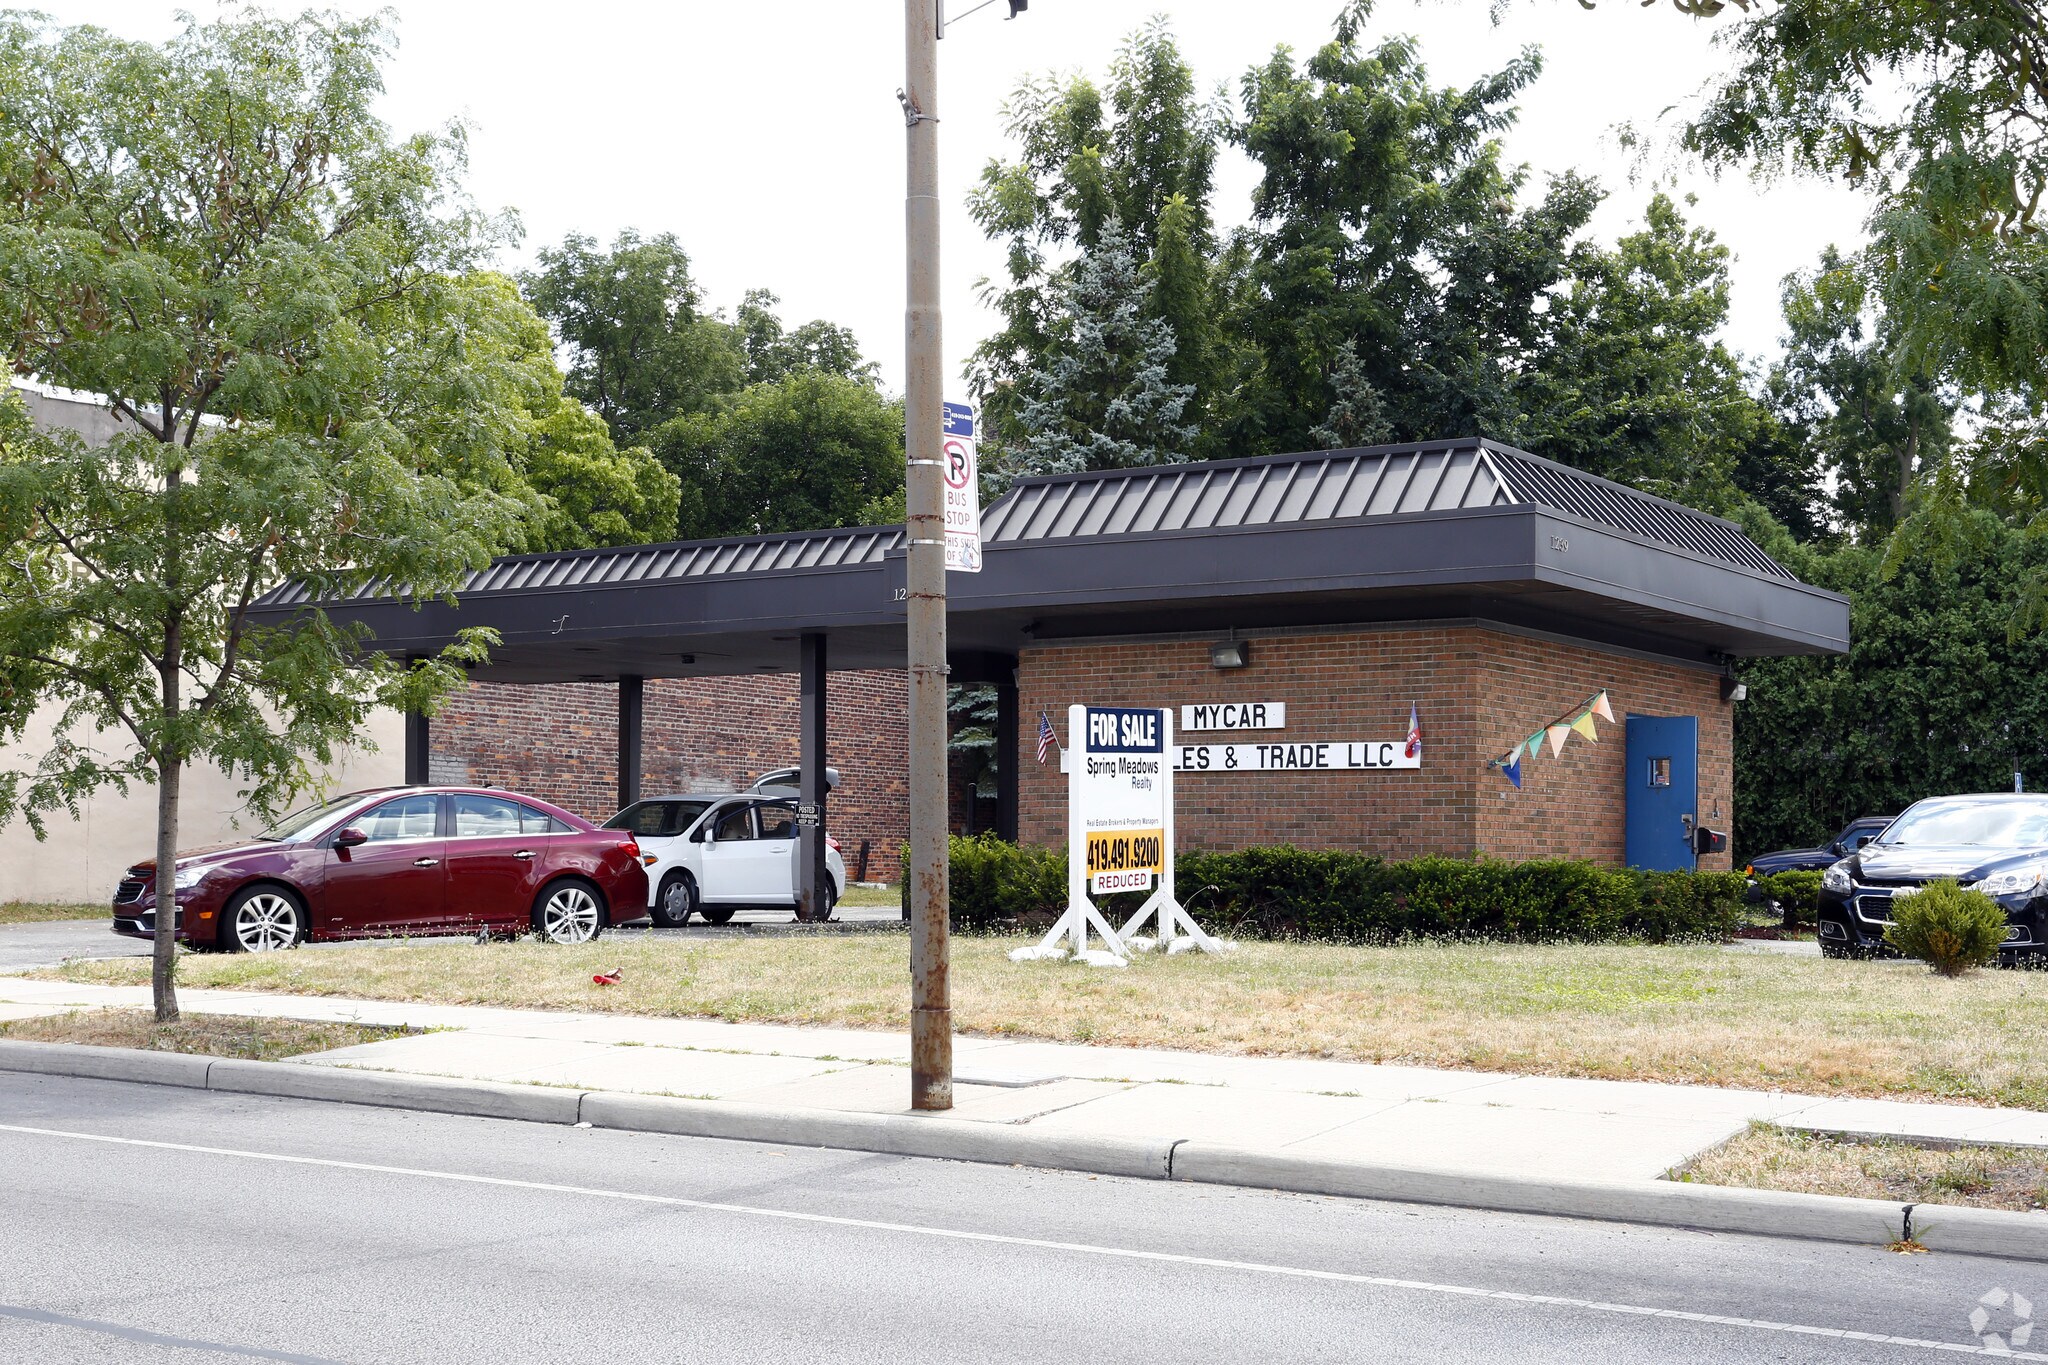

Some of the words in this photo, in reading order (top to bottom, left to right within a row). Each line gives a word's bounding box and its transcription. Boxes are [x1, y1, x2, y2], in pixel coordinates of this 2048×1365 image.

[948, 491, 967, 506] BUS
[946, 511, 970, 525] STOP
[960, 538, 975, 548] SIDE
[946, 550, 956, 561] OF
[958, 551, 974, 562] SN
[1194, 704, 1266, 728] MYCAR
[1090, 713, 1118, 746] FOR
[1121, 714, 1156, 747] SALE
[1225, 746, 1238, 769] &
[1256, 744, 1329, 768] TRADE
[1348, 743, 1393, 767] LLC
[1087, 757, 1116, 778] Spring
[1119, 757, 1159, 774] Meadows
[1132, 776, 1152, 791] Realty
[798, 806, 815, 814] POSTED
[1096, 818, 1107, 826] Estate
[1108, 818, 1122, 826] Brokers
[1127, 818, 1141, 826] Property
[1142, 817, 1159, 825] Managers
[1087, 836, 1159, 870] 419.491.9200
[1098, 873, 1147, 889] REDUCED
